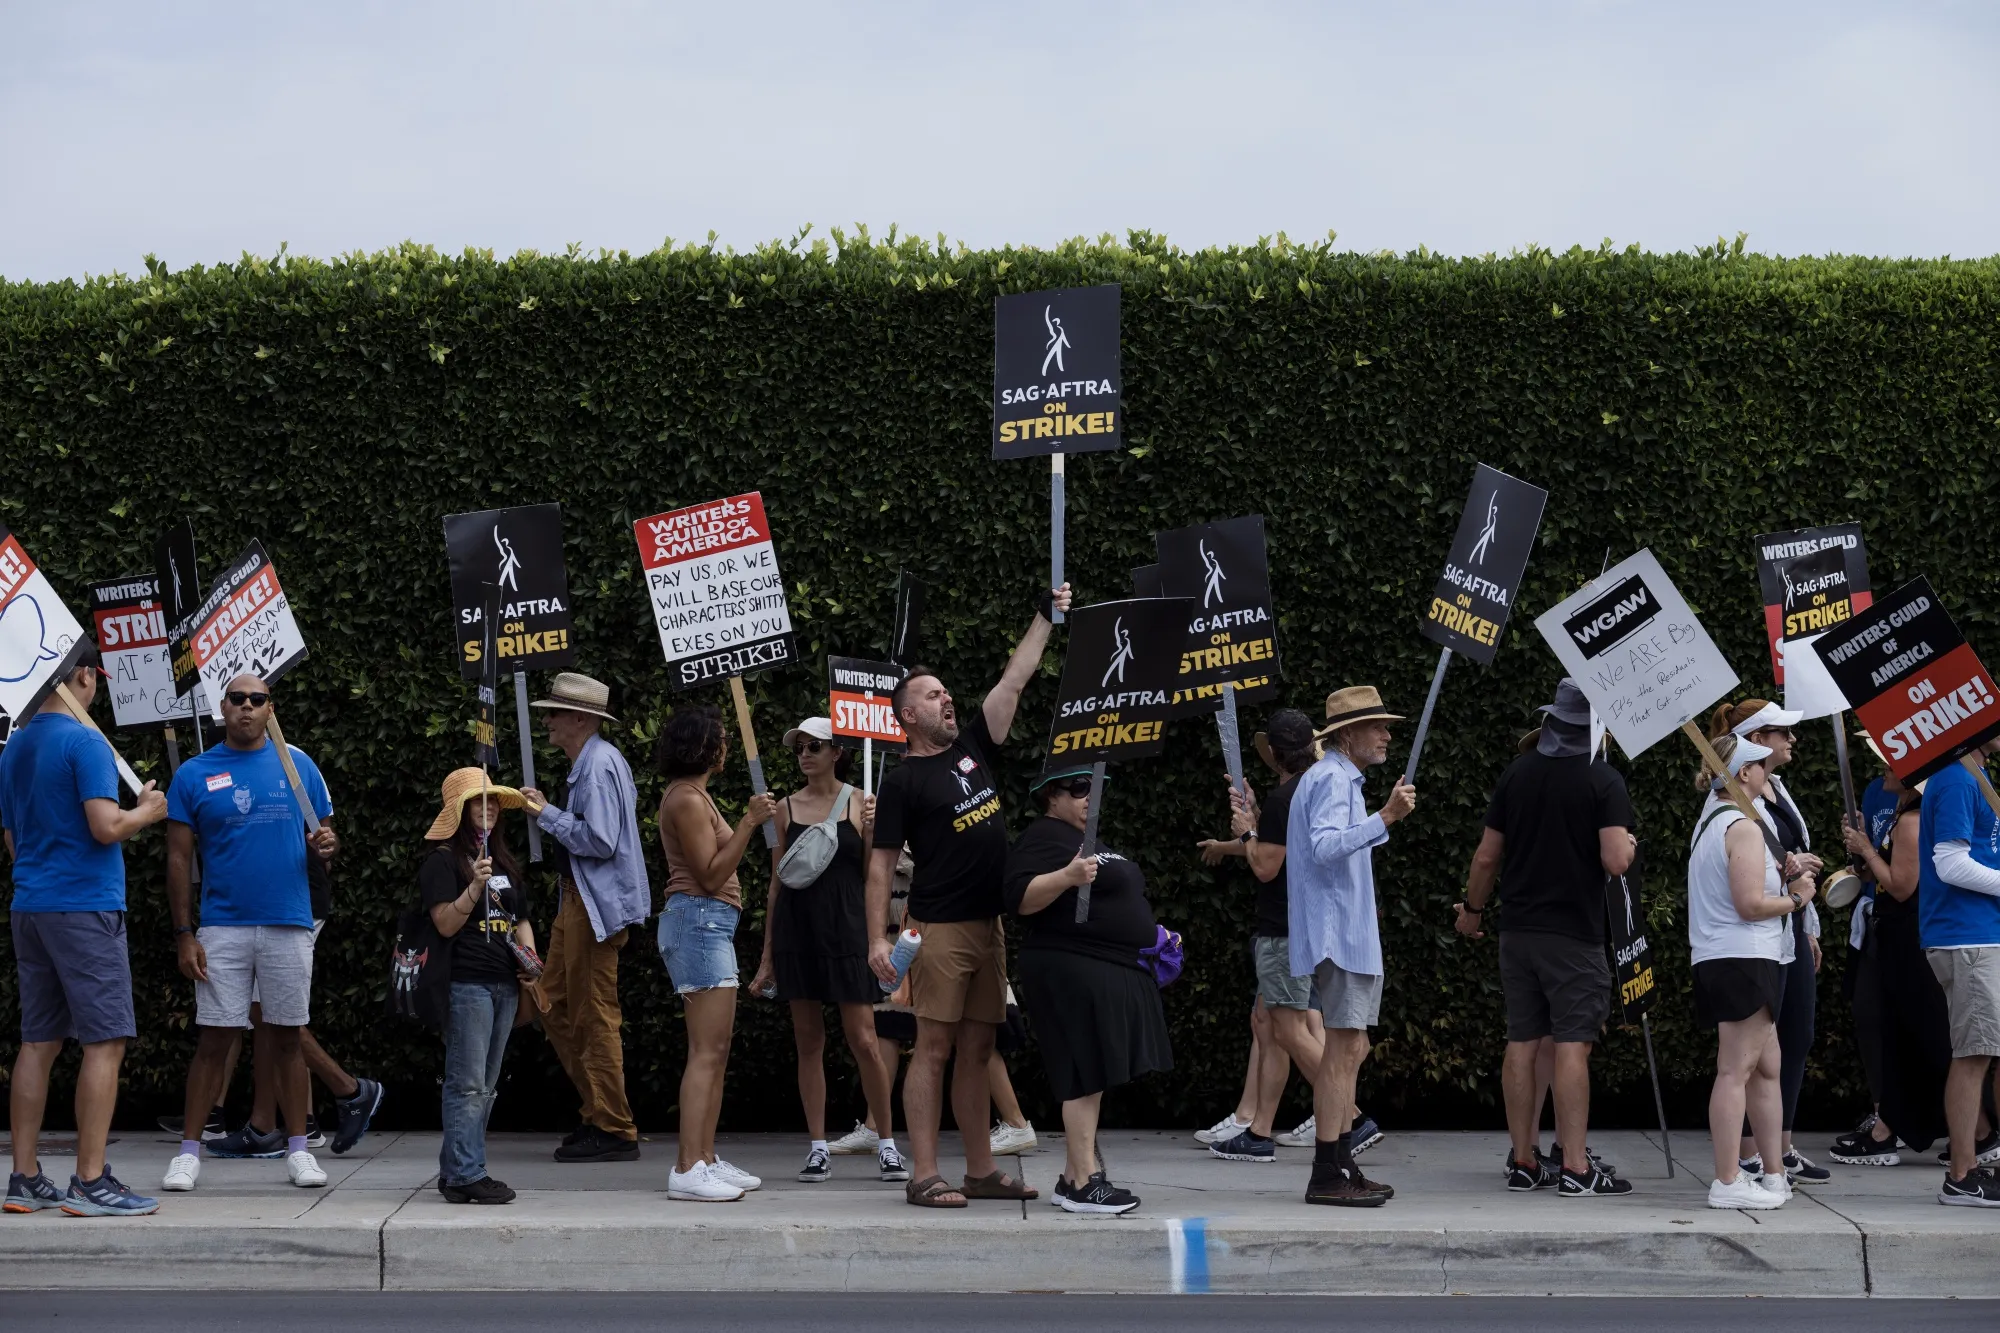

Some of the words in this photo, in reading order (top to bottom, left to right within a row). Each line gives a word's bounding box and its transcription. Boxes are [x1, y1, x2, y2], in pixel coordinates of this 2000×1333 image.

[1043, 401, 1067, 414] ON
[999, 411, 1115, 443] STRIKE!
[648, 499, 751, 534] WRITERS
[654, 521, 725, 547] GUILD
[726, 516, 749, 529] OF
[653, 526, 760, 562] AMERICA
[1761, 539, 1819, 561] WRITERS
[650, 570, 681, 590] PAY
[717, 558, 739, 576] OR
[743, 550, 771, 569] WE
[95, 581, 153, 602] WRITERS
[140, 599, 153, 609] ON
[190, 581, 231, 629] WRITERS
[230, 553, 261, 586] GUILD
[221, 595, 233, 607] ON
[657, 590, 703, 610] WILL
[707, 580, 750, 601] BASE
[750, 573, 782, 591] OUR
[749, 593, 785, 612] SHITTY
[1456, 593, 1473, 609] ON
[1812, 592, 1827, 606] ON
[197, 573, 273, 660] STRIKE!
[242, 597, 286, 645] ASKING
[503, 621, 525, 634] ON
[1428, 597, 1500, 647] STRIKE!
[1573, 587, 1648, 644] WGAW
[1786, 598, 1851, 636] STRIKE!
[1827, 619, 1891, 665] WRITERS
[1889, 596, 1931, 628] GUILD
[464, 629, 568, 662] SRIKE!
[672, 633, 715, 653] EXES
[720, 624, 745, 642] ON
[752, 618, 782, 636] YOU
[1210, 632, 1231, 645] ON
[1881, 637, 1899, 655] OF
[117, 654, 138, 683] AI
[217, 654, 243, 690] 2%
[242, 621, 280, 660] FROM
[680, 639, 788, 684] STRIKE
[1179, 638, 1274, 674] STRIKE!
[1590, 663, 1625, 692] We
[1629, 635, 1668, 673] ARE
[1667, 623, 1696, 645] Big
[1870, 641, 1935, 688] AMERICA
[140, 687, 148, 701] A
[834, 668, 875, 688] WRITERS
[864, 690, 874, 700] ON
[1609, 696, 1633, 720] It's
[1637, 683, 1655, 698] the
[1656, 656, 1696, 686] Residuals
[1907, 678, 1937, 705] ON
[1628, 707, 1652, 727] That
[1674, 675, 1702, 701] Small
[1882, 675, 1995, 761] STRIKE!
[1097, 713, 1120, 725] ON
[1051, 720, 1163, 755] STRIKE!
[1633, 961, 1641, 974] ON
[1621, 966, 1655, 1006] STRIKE!
